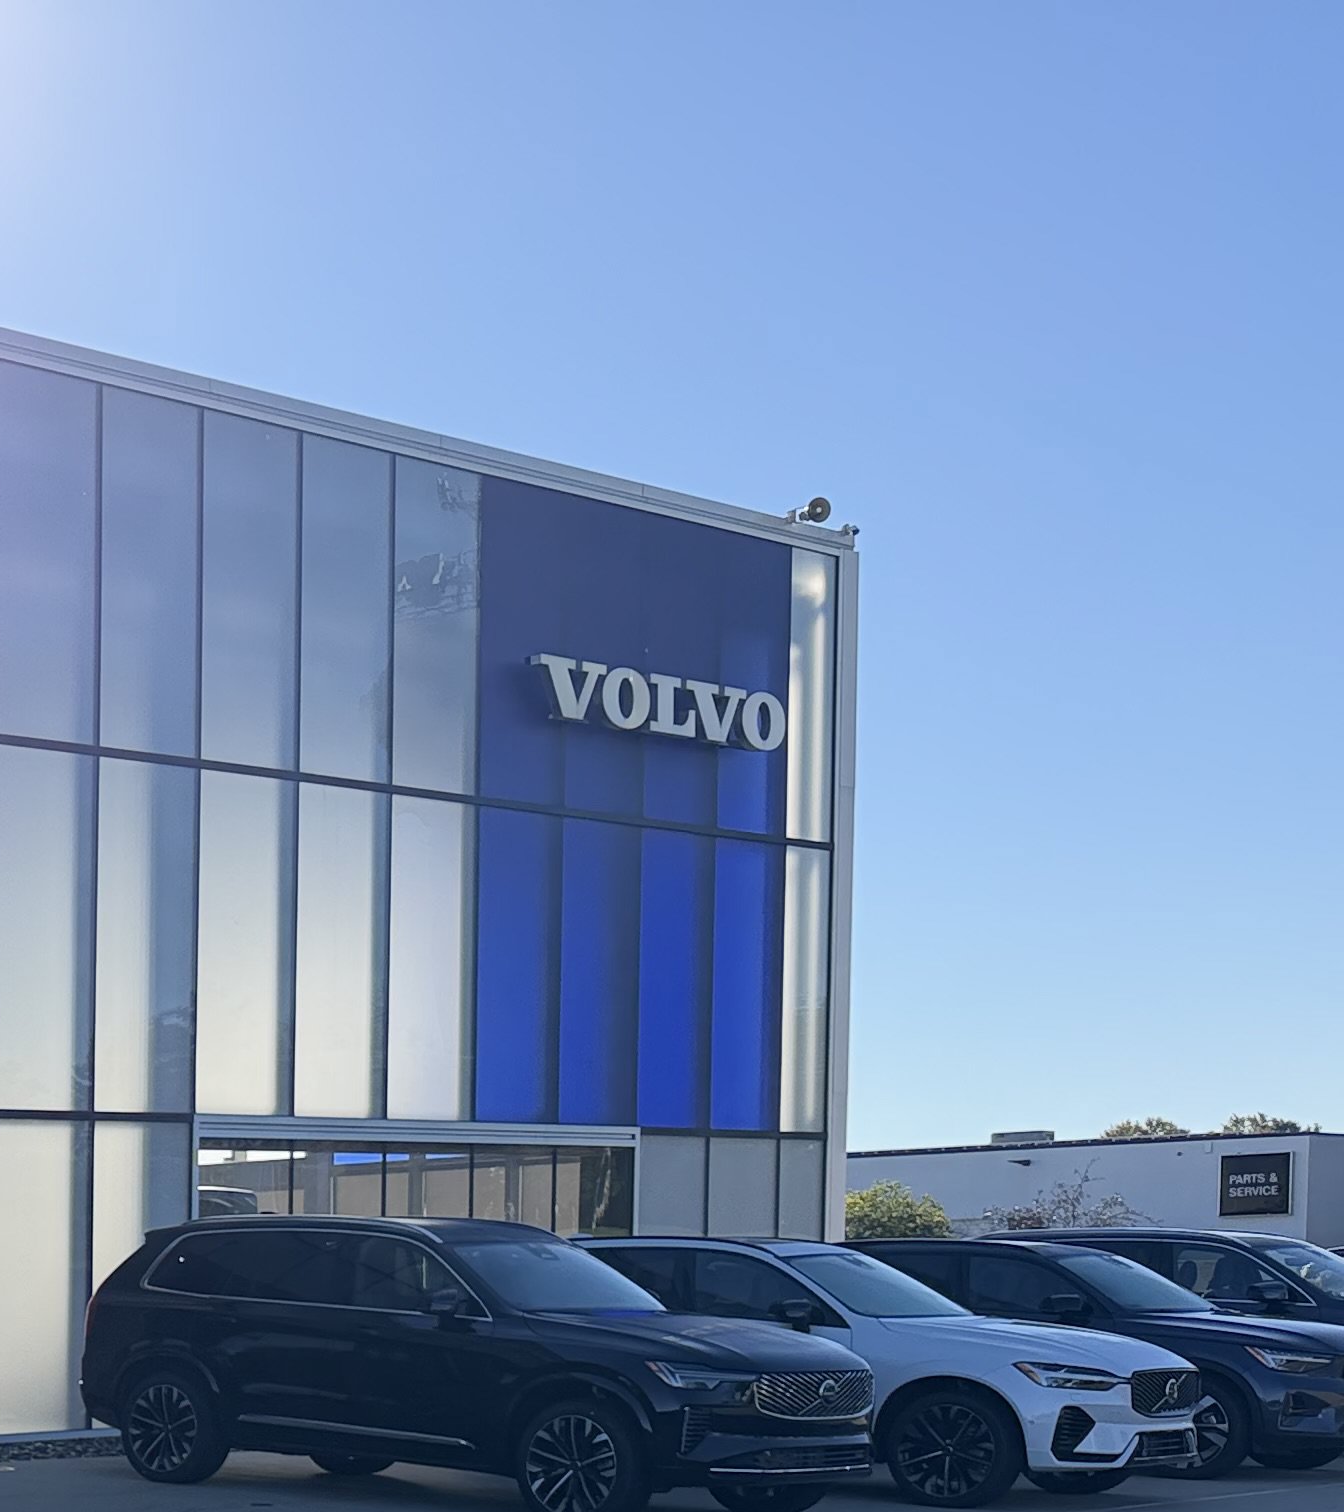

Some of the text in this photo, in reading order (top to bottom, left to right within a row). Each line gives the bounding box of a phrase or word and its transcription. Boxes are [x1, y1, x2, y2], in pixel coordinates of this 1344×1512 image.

[531, 653, 786, 752] VOLVO
[1229, 1172, 1279, 1185] PARTS &
[1228, 1185, 1279, 1197] SERVICE
